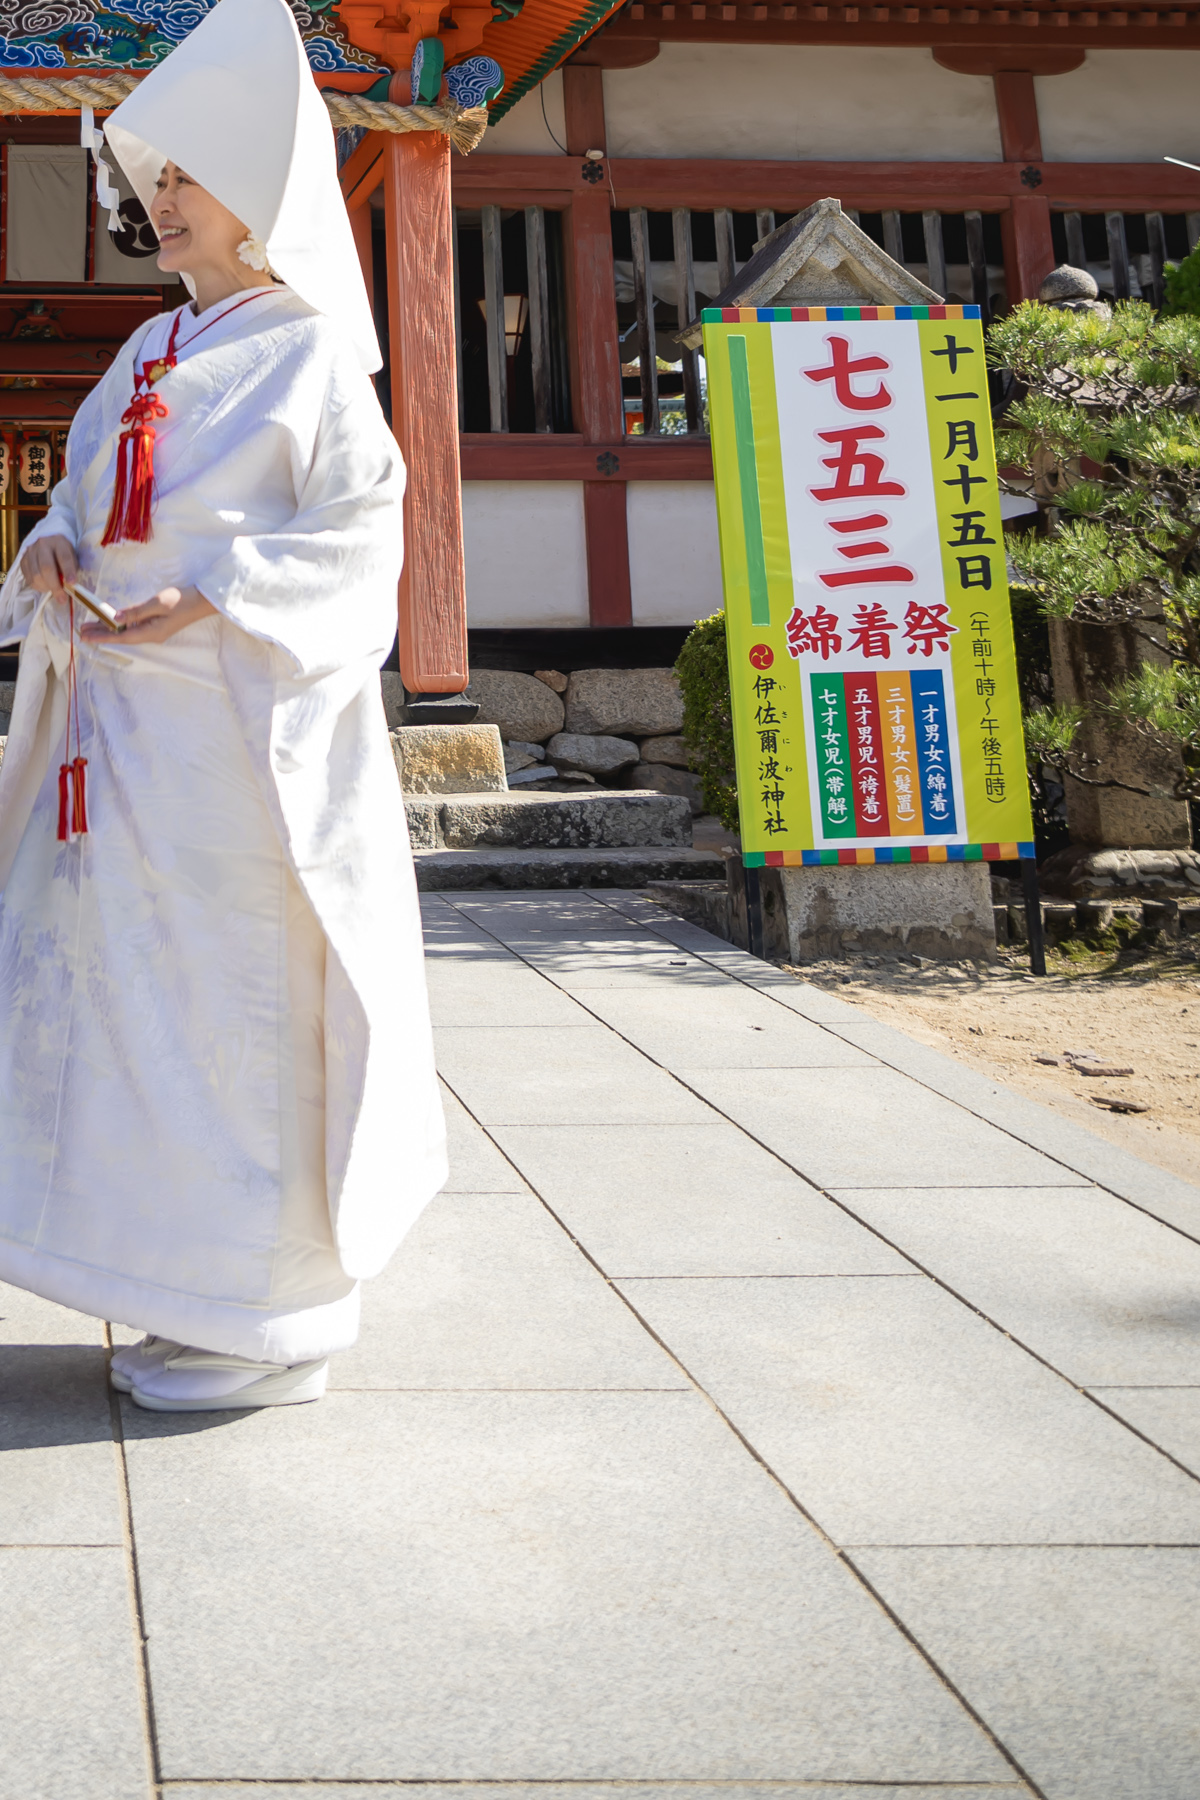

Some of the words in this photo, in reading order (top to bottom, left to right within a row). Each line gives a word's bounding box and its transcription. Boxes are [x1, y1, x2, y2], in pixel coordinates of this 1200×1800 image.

[28, 445, 46, 487] 御神燈
[803, 335, 915, 588] 七五三
[930, 335, 996, 590] 十一月十五日
[785, 600, 958, 661] 綿着祭
[752, 674, 788, 837] 伊佐爾波神社
[818, 688, 848, 824] 七才女児（帯解）
[852, 688, 882, 823] 五才男児（袴着）
[919, 690, 950, 821] 一才男女（綿着）
